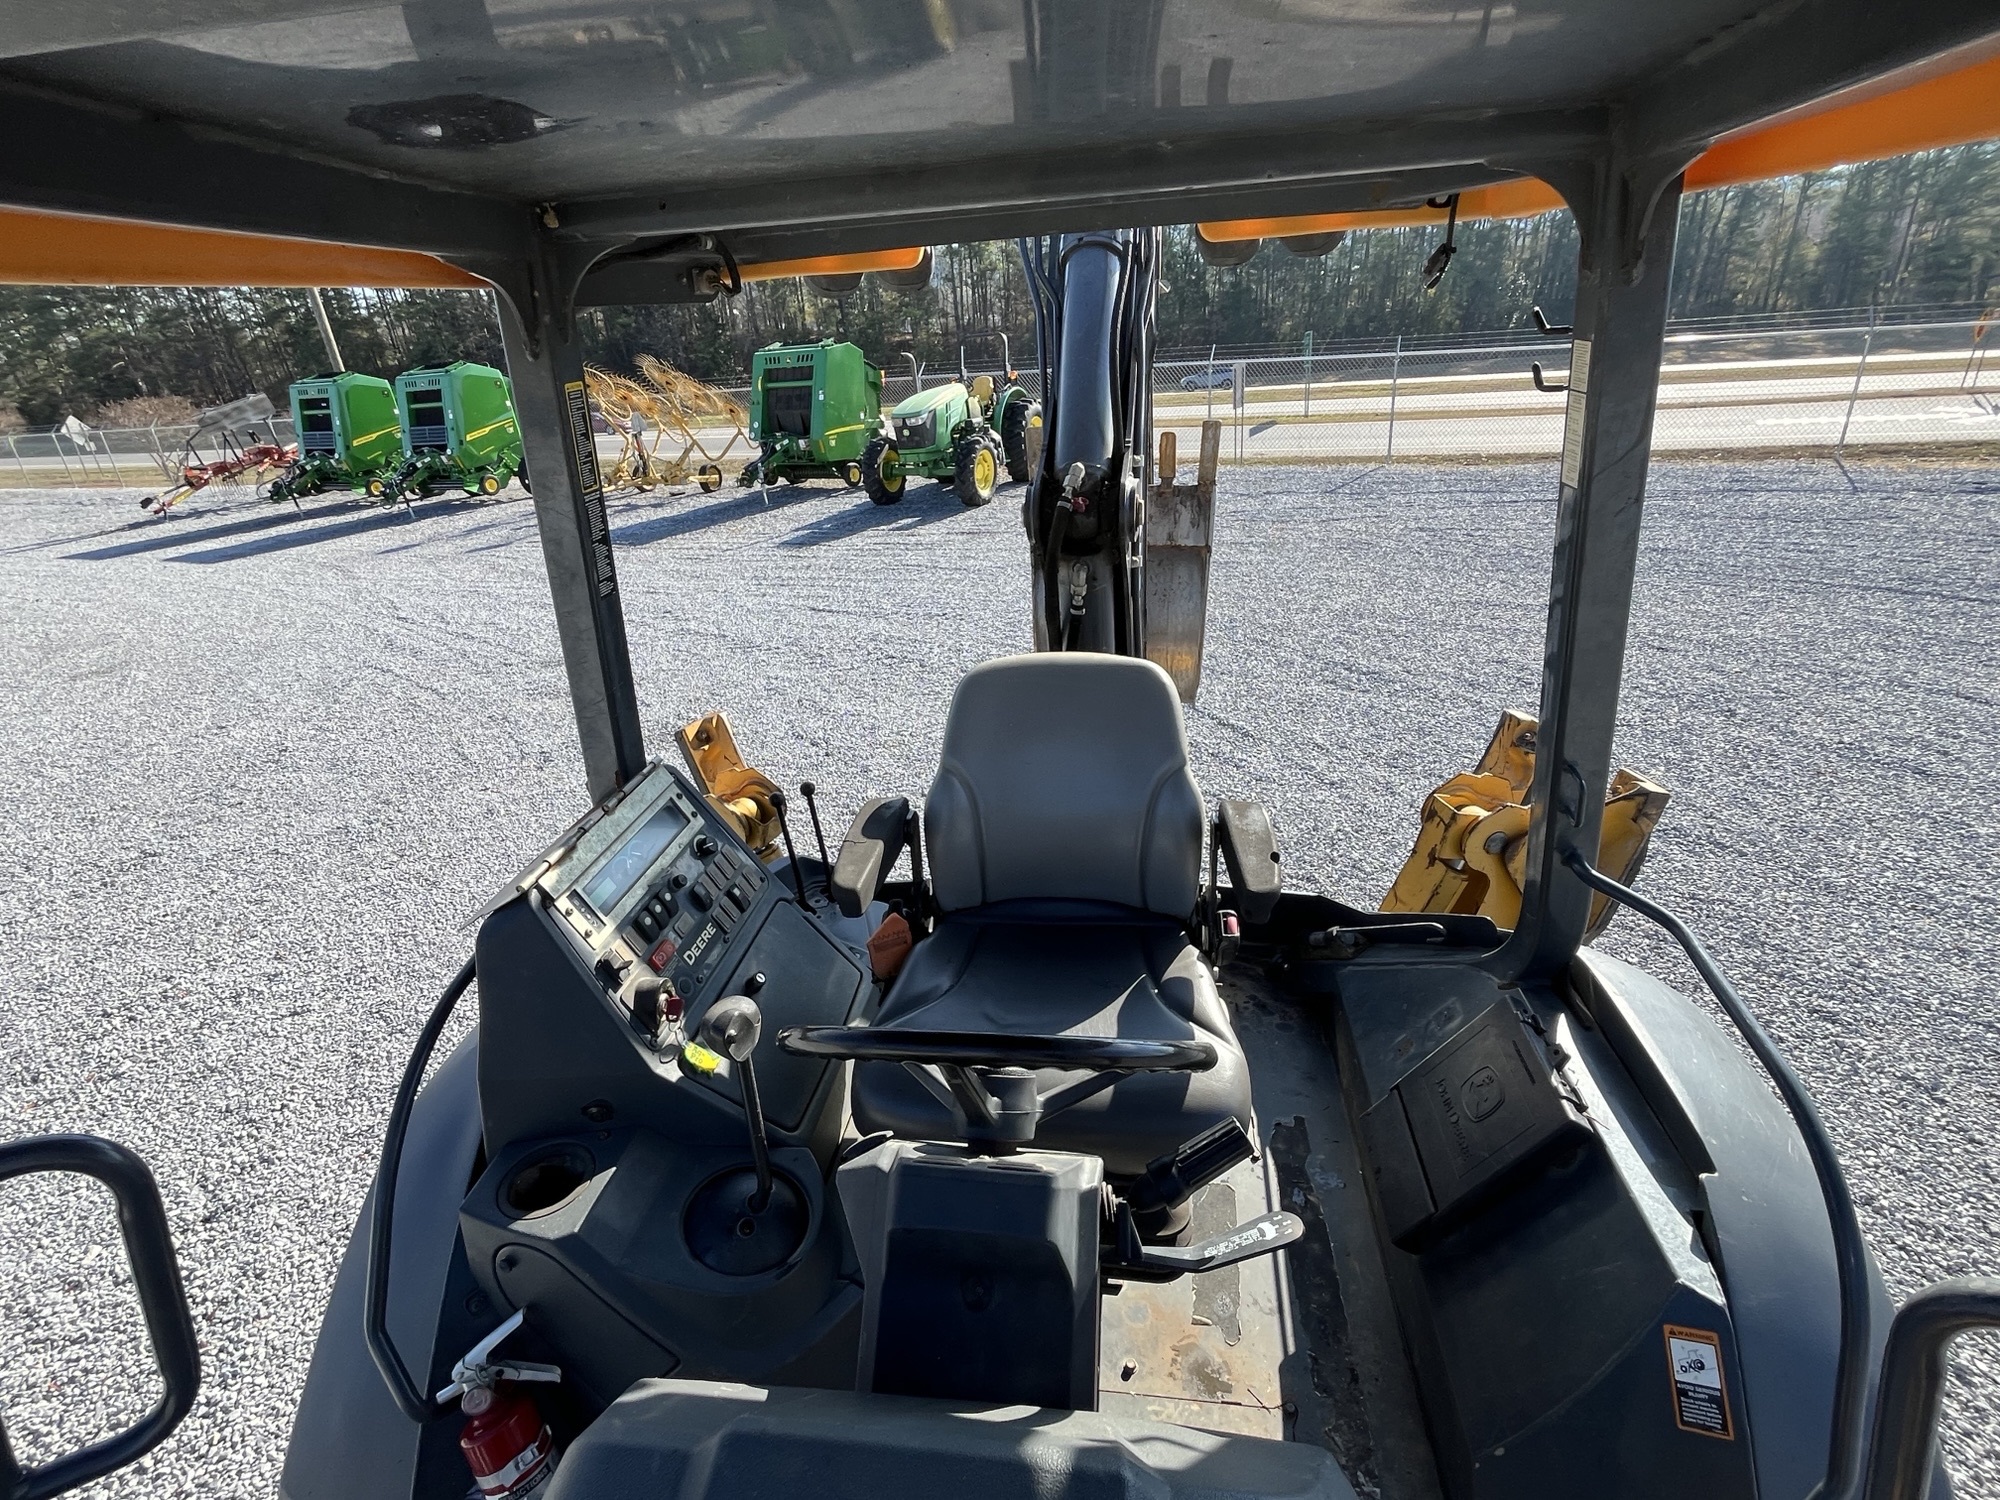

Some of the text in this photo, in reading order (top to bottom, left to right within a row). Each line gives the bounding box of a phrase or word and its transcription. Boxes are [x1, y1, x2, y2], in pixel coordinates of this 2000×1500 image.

[683, 922, 717, 966] DEERE
[1676, 1330, 1715, 1342] WARNING
[503, 1467, 549, 1500] RUCTIONS
